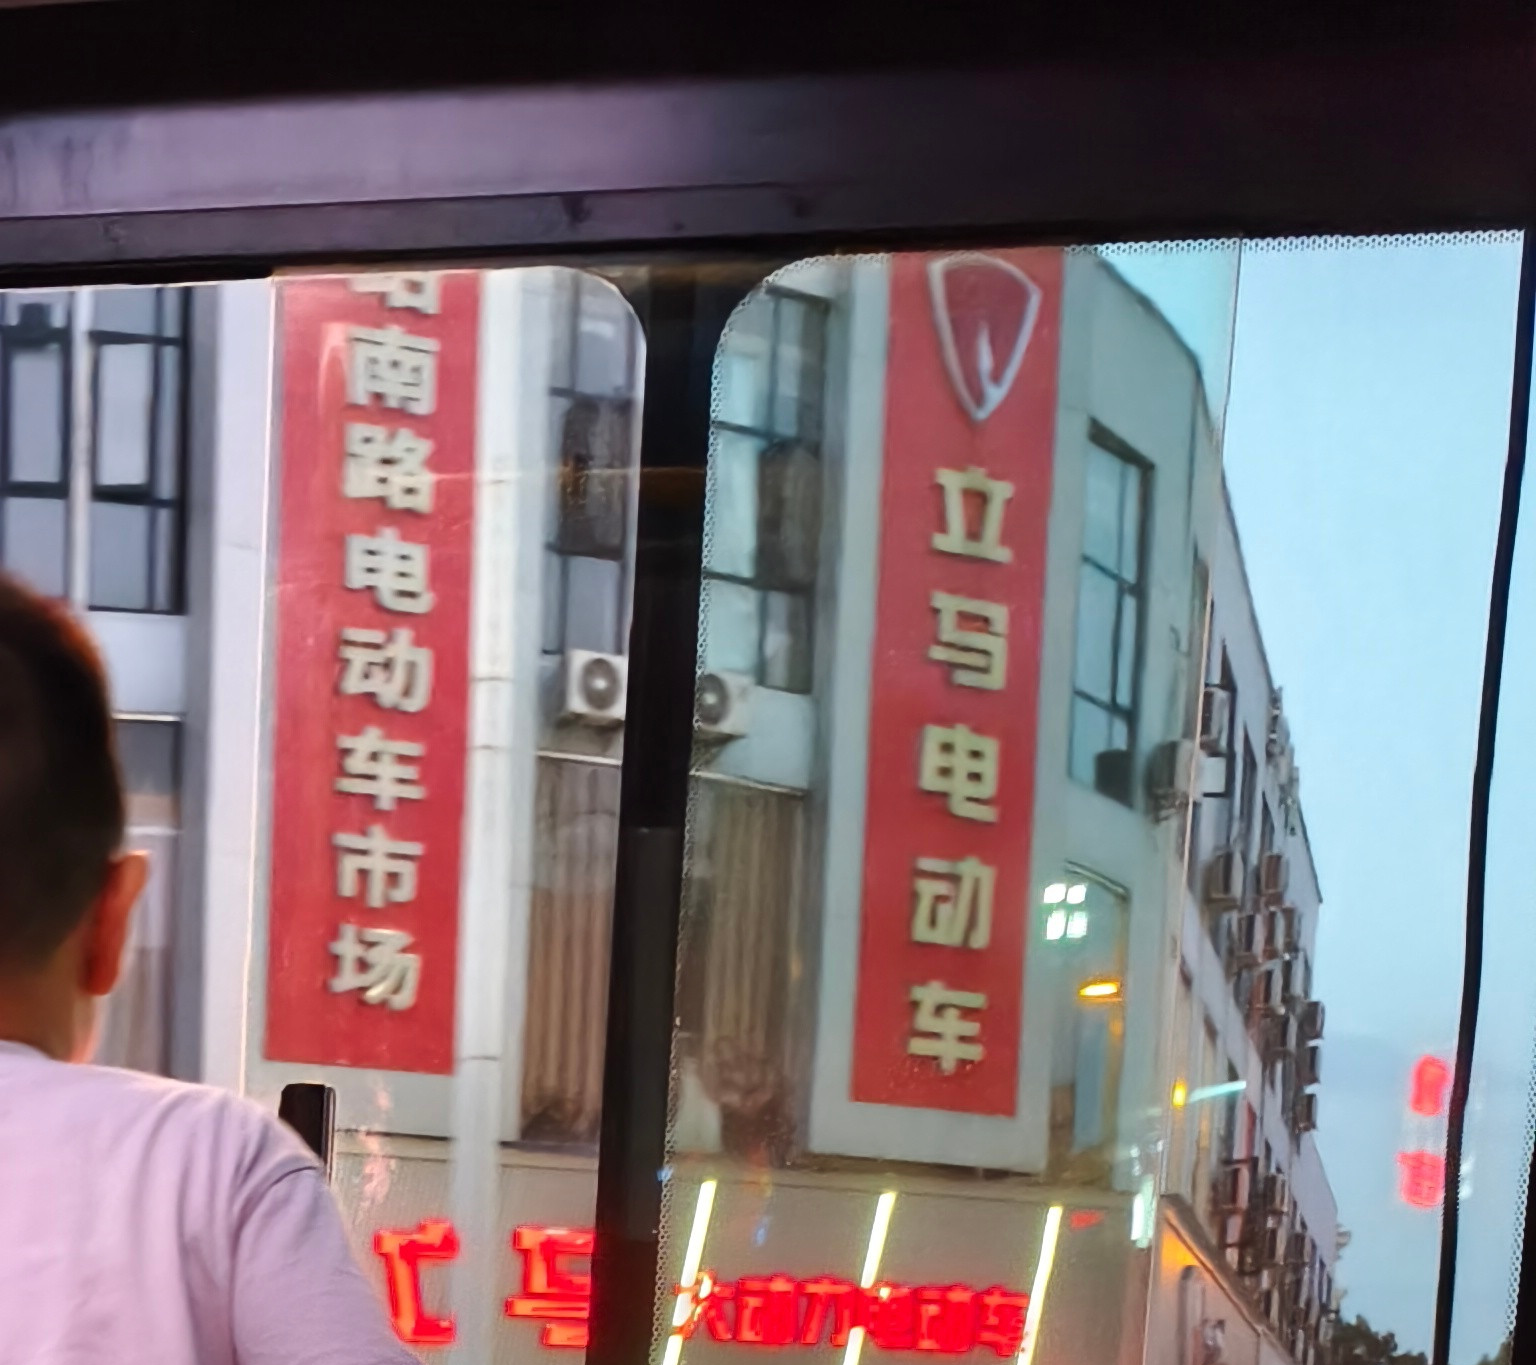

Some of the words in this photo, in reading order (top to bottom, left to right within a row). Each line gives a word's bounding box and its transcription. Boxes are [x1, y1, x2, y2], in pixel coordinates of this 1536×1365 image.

[908, 466, 1015, 1077] 立马电动车
